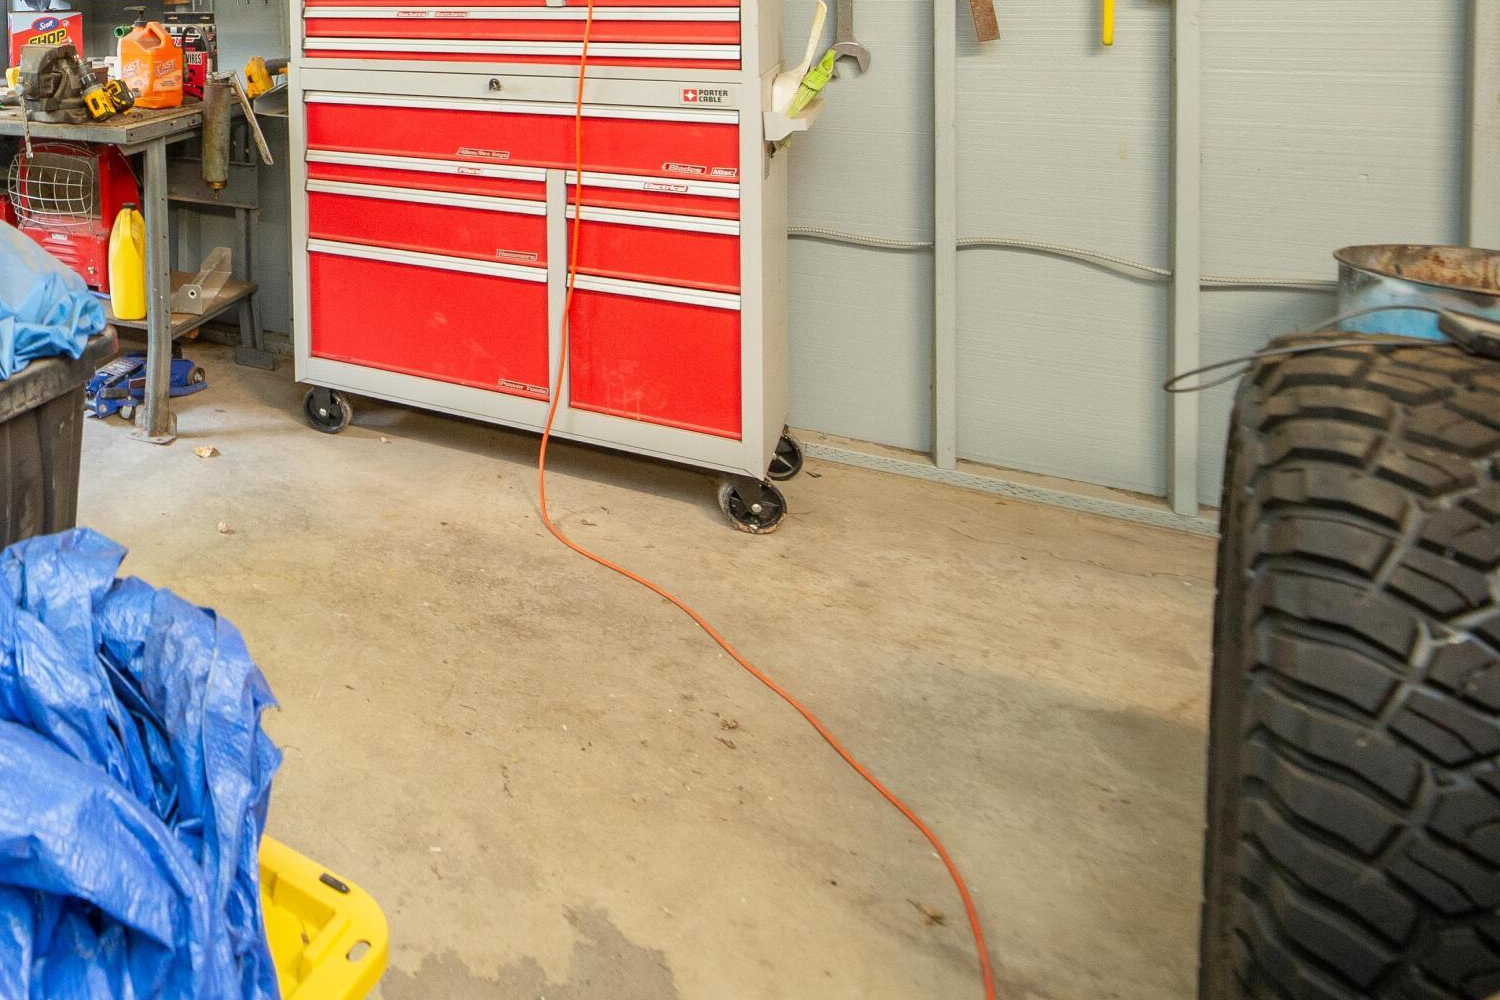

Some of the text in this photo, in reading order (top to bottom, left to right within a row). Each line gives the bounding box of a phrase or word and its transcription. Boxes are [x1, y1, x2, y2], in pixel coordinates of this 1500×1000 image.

[39, 20, 53, 30] Scott
[30, 29, 66, 44] SHOP
[699, 89, 728, 97] PORTER
[667, 164, 703, 174] Blades
[713, 168, 735, 177] Misc
[500, 380, 523, 390] Power
